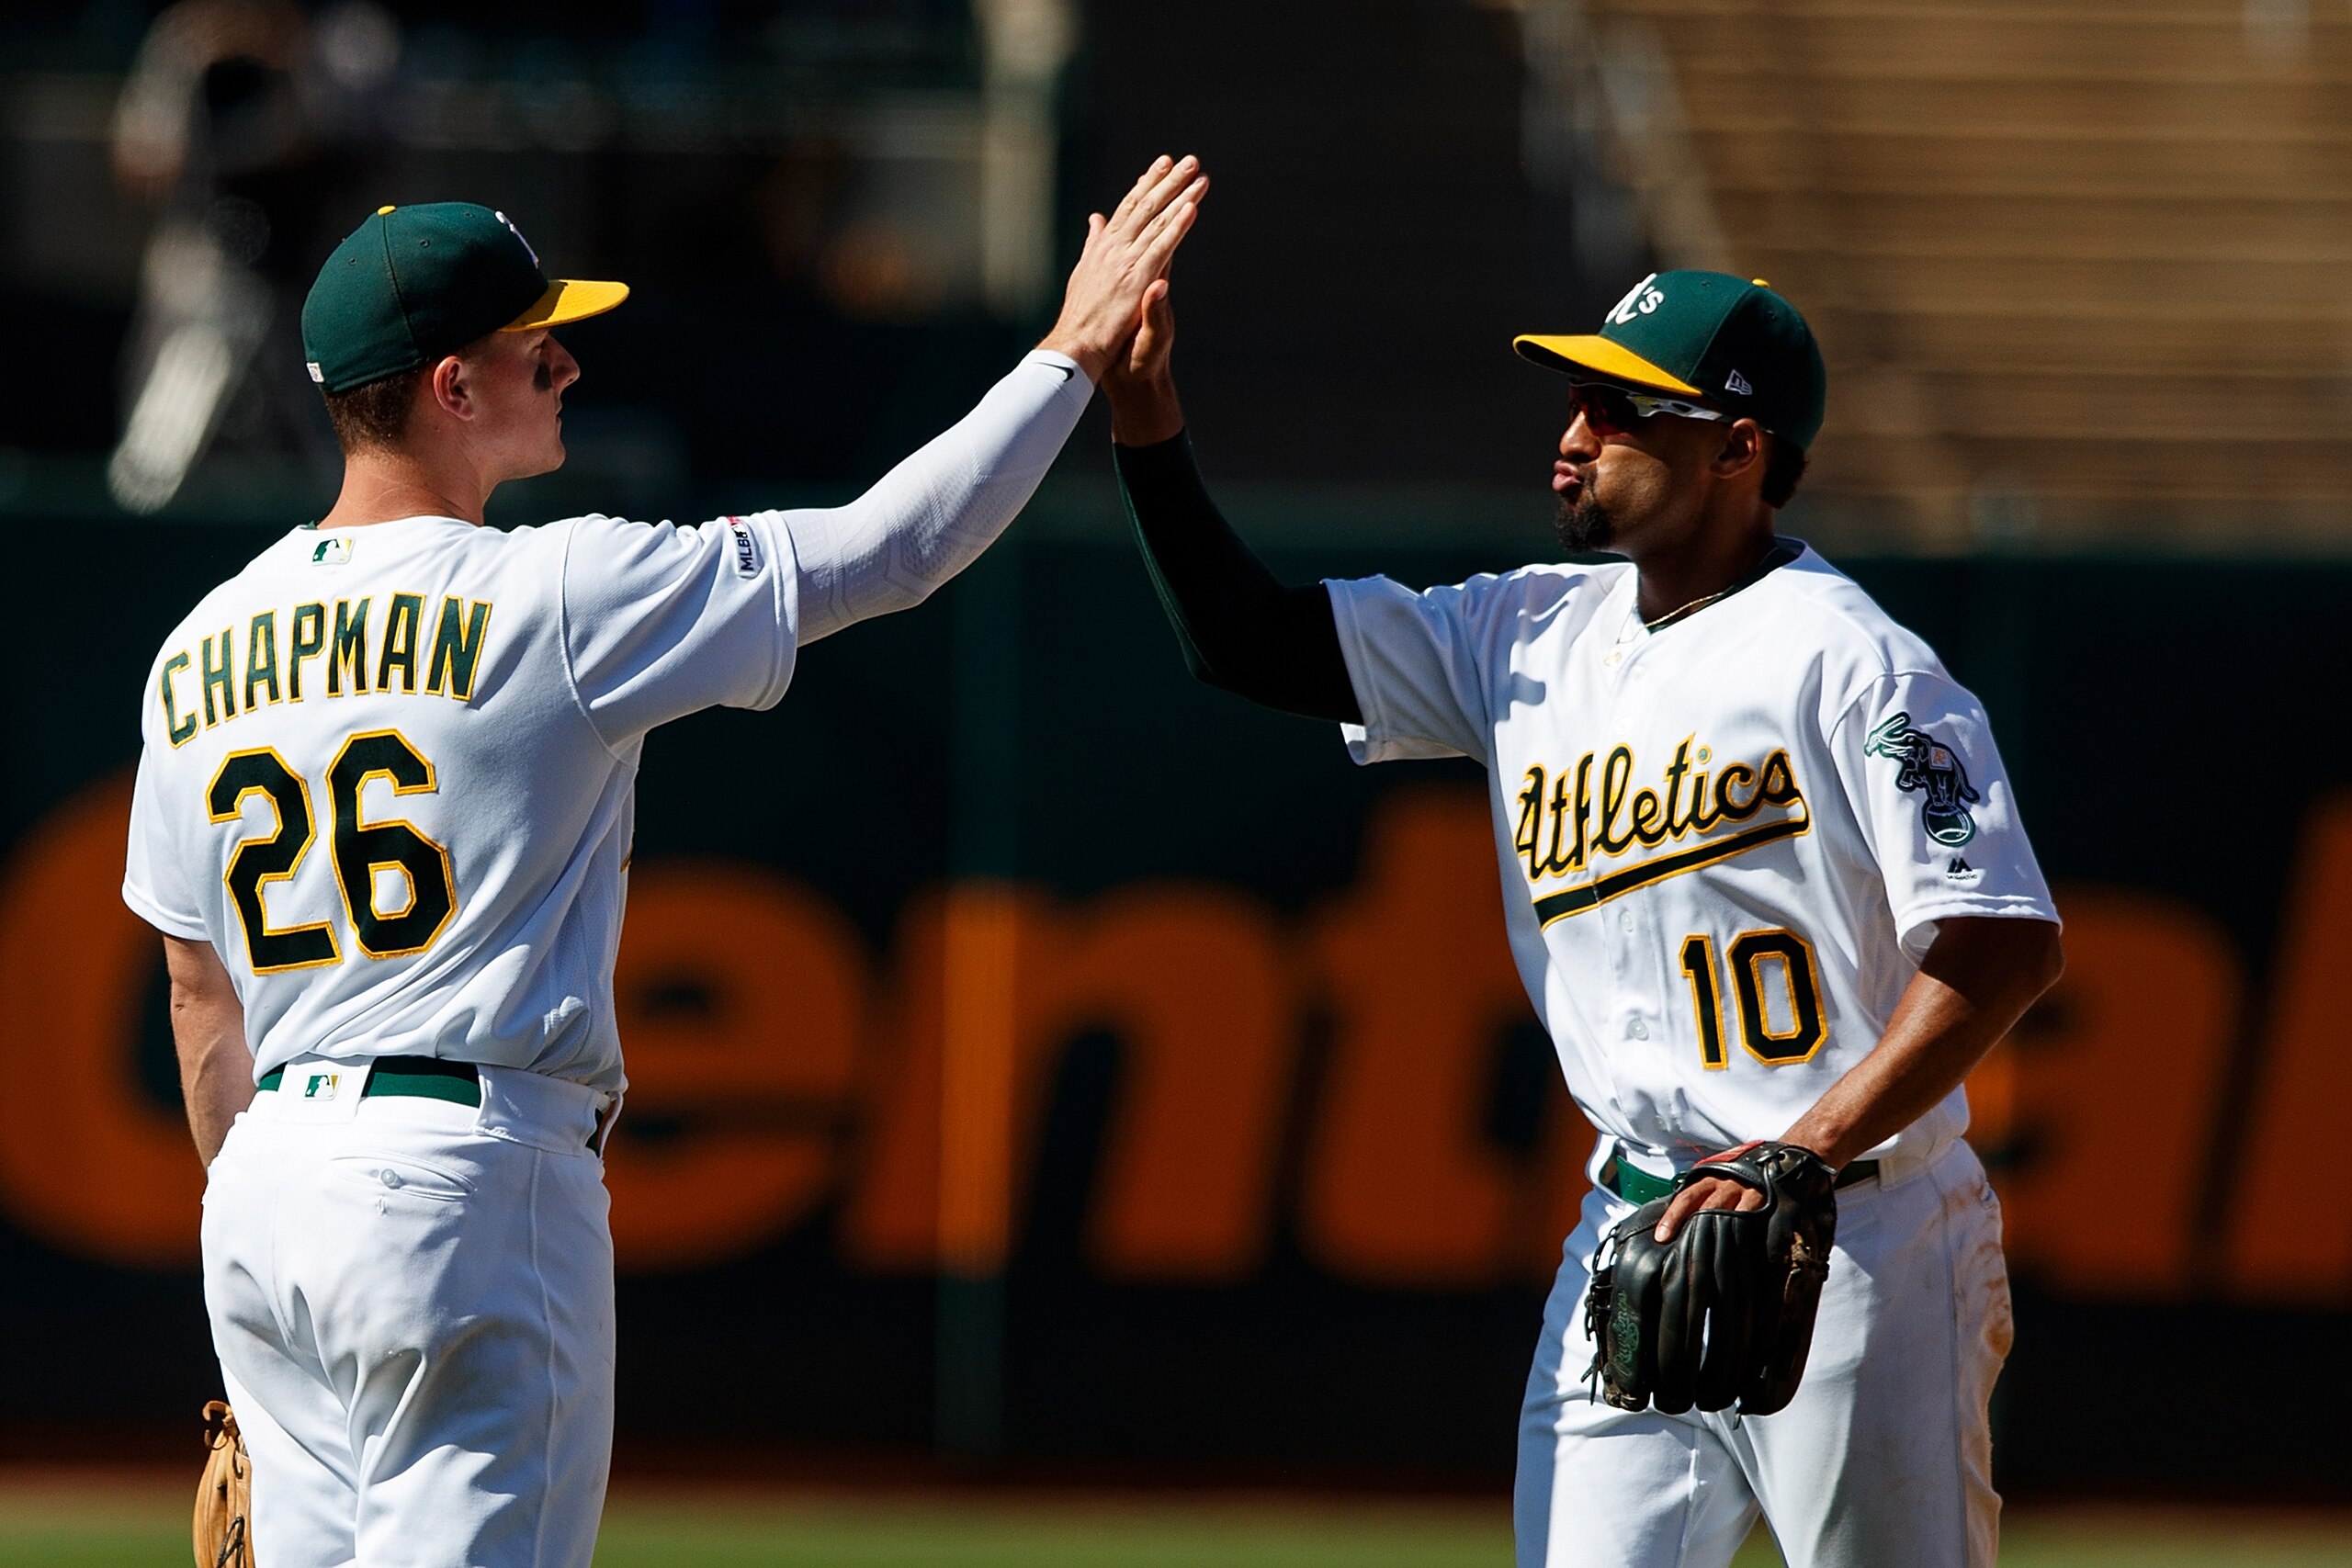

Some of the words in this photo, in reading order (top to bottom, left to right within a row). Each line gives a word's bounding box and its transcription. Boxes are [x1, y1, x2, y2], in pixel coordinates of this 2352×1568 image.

[159, 592, 492, 749] CHAPMAN
[205, 728, 458, 976] 26
[1516, 732, 1801, 884] Athletics
[1678, 927, 1828, 1070] 10
